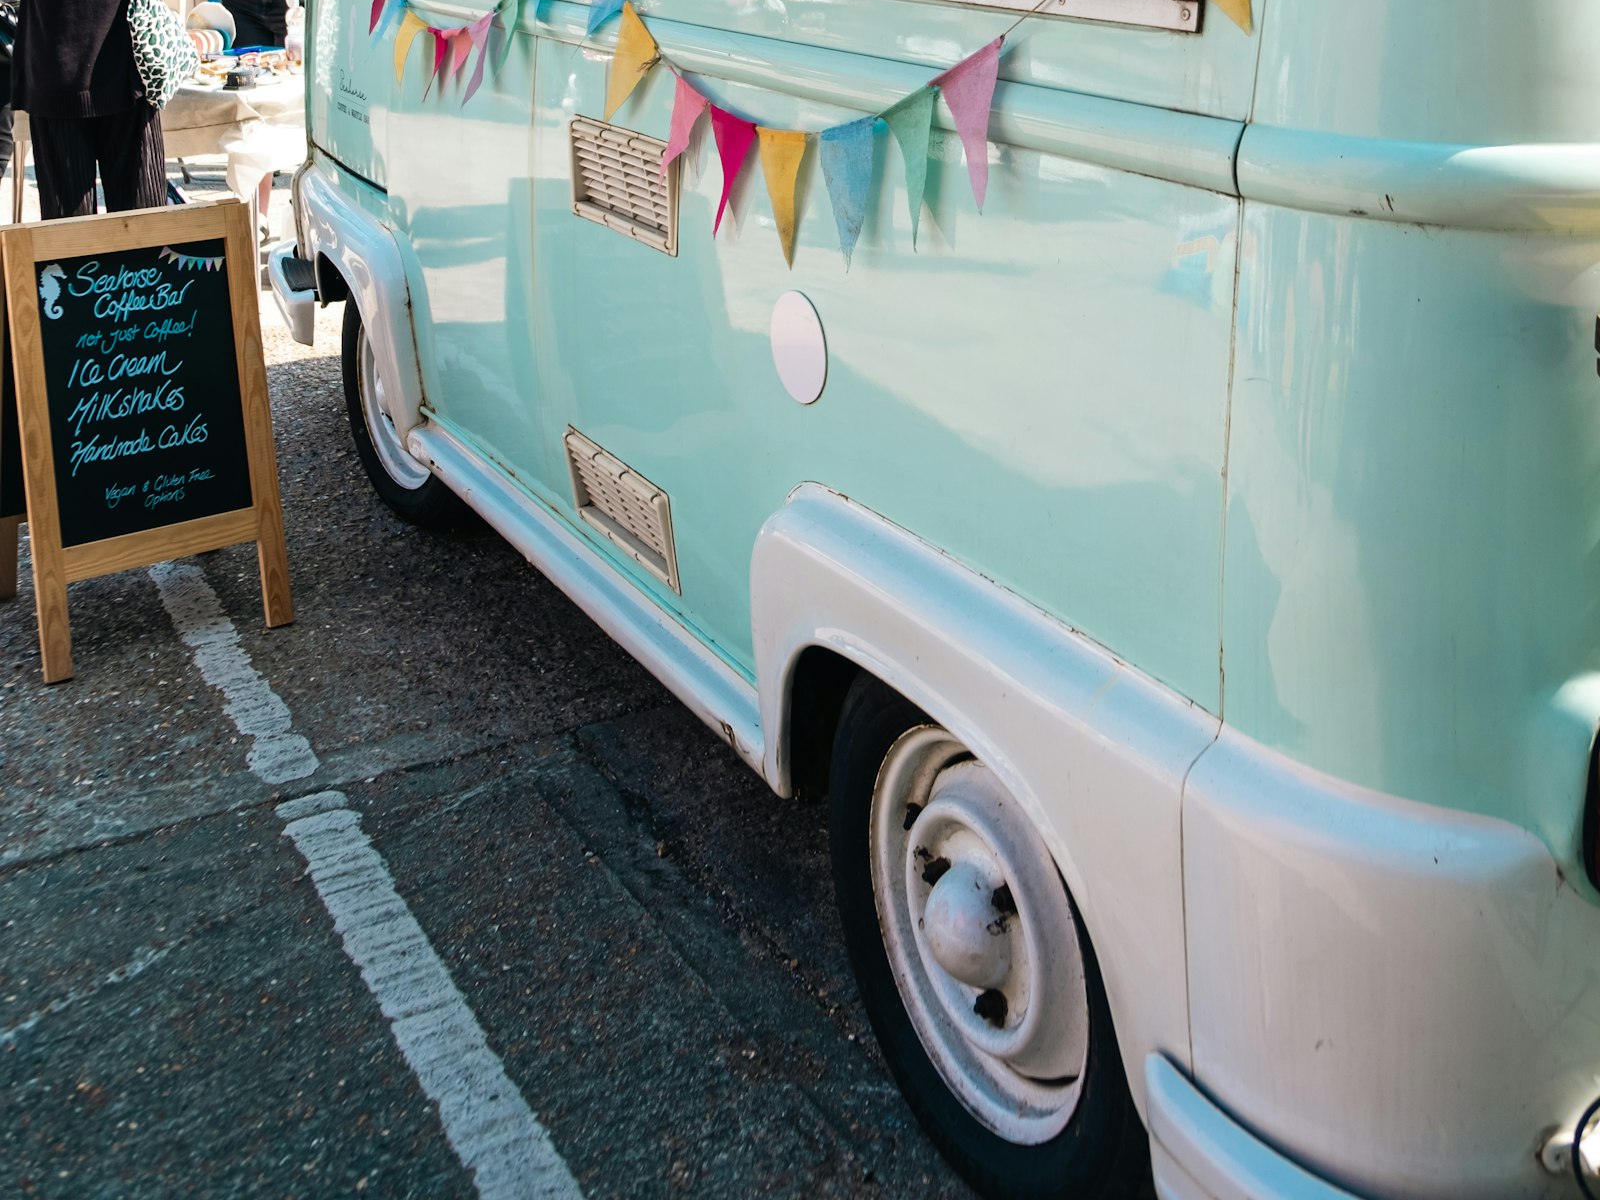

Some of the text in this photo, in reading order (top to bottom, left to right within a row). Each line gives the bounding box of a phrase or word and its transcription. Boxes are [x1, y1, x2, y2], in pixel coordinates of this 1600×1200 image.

[67, 260, 163, 297] Seahorse
[93, 279, 195, 323] Coffee Bar
[75, 330, 102, 348] not
[107, 350, 184, 381] Cream
[70, 427, 156, 477] Handmade
[105, 483, 137, 509] Vegan
[153, 474, 185, 491] Gluten
[188, 467, 216, 483] Free
